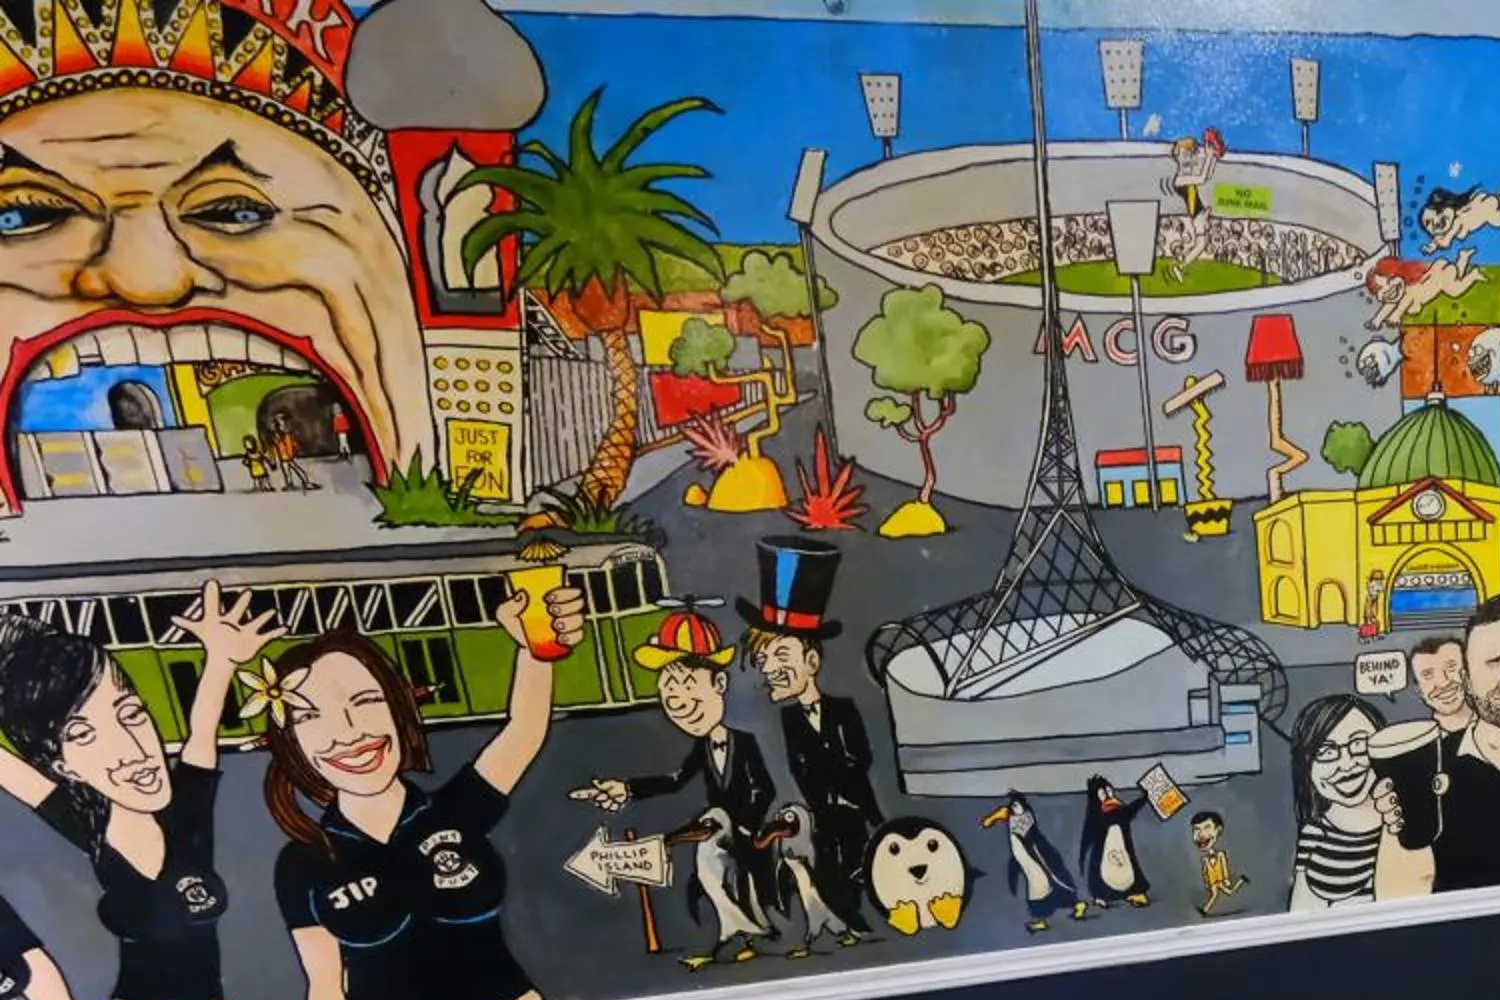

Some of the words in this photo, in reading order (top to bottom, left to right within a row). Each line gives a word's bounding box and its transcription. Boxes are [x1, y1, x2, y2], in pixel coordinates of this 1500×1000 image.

[1032, 311, 1198, 367] MCG
[453, 427, 499, 445] JUST
[465, 449, 493, 465] FOR
[1359, 659, 1401, 675] BEHIND
[590, 847, 648, 861] PHILLIP
[598, 860, 653, 871] ISLAND
[328, 876, 378, 910] JIP
